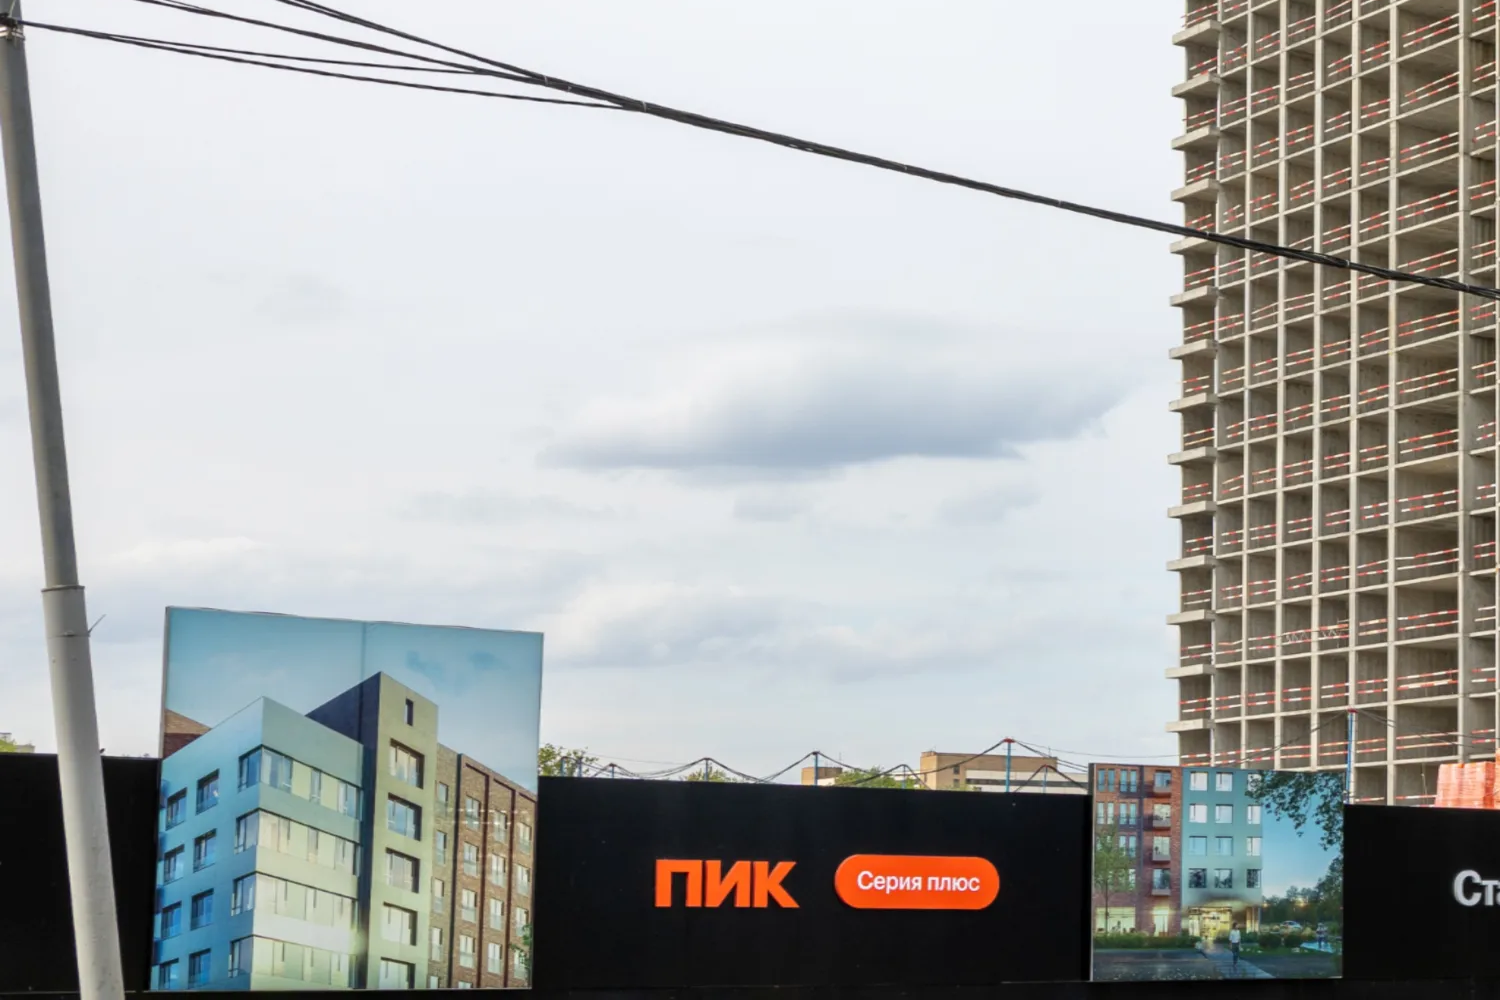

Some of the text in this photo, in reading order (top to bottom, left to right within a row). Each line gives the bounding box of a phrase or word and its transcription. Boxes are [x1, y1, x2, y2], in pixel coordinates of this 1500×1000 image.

[655, 859, 799, 908] ПИК
[857, 870, 981, 895] Серия плюс
